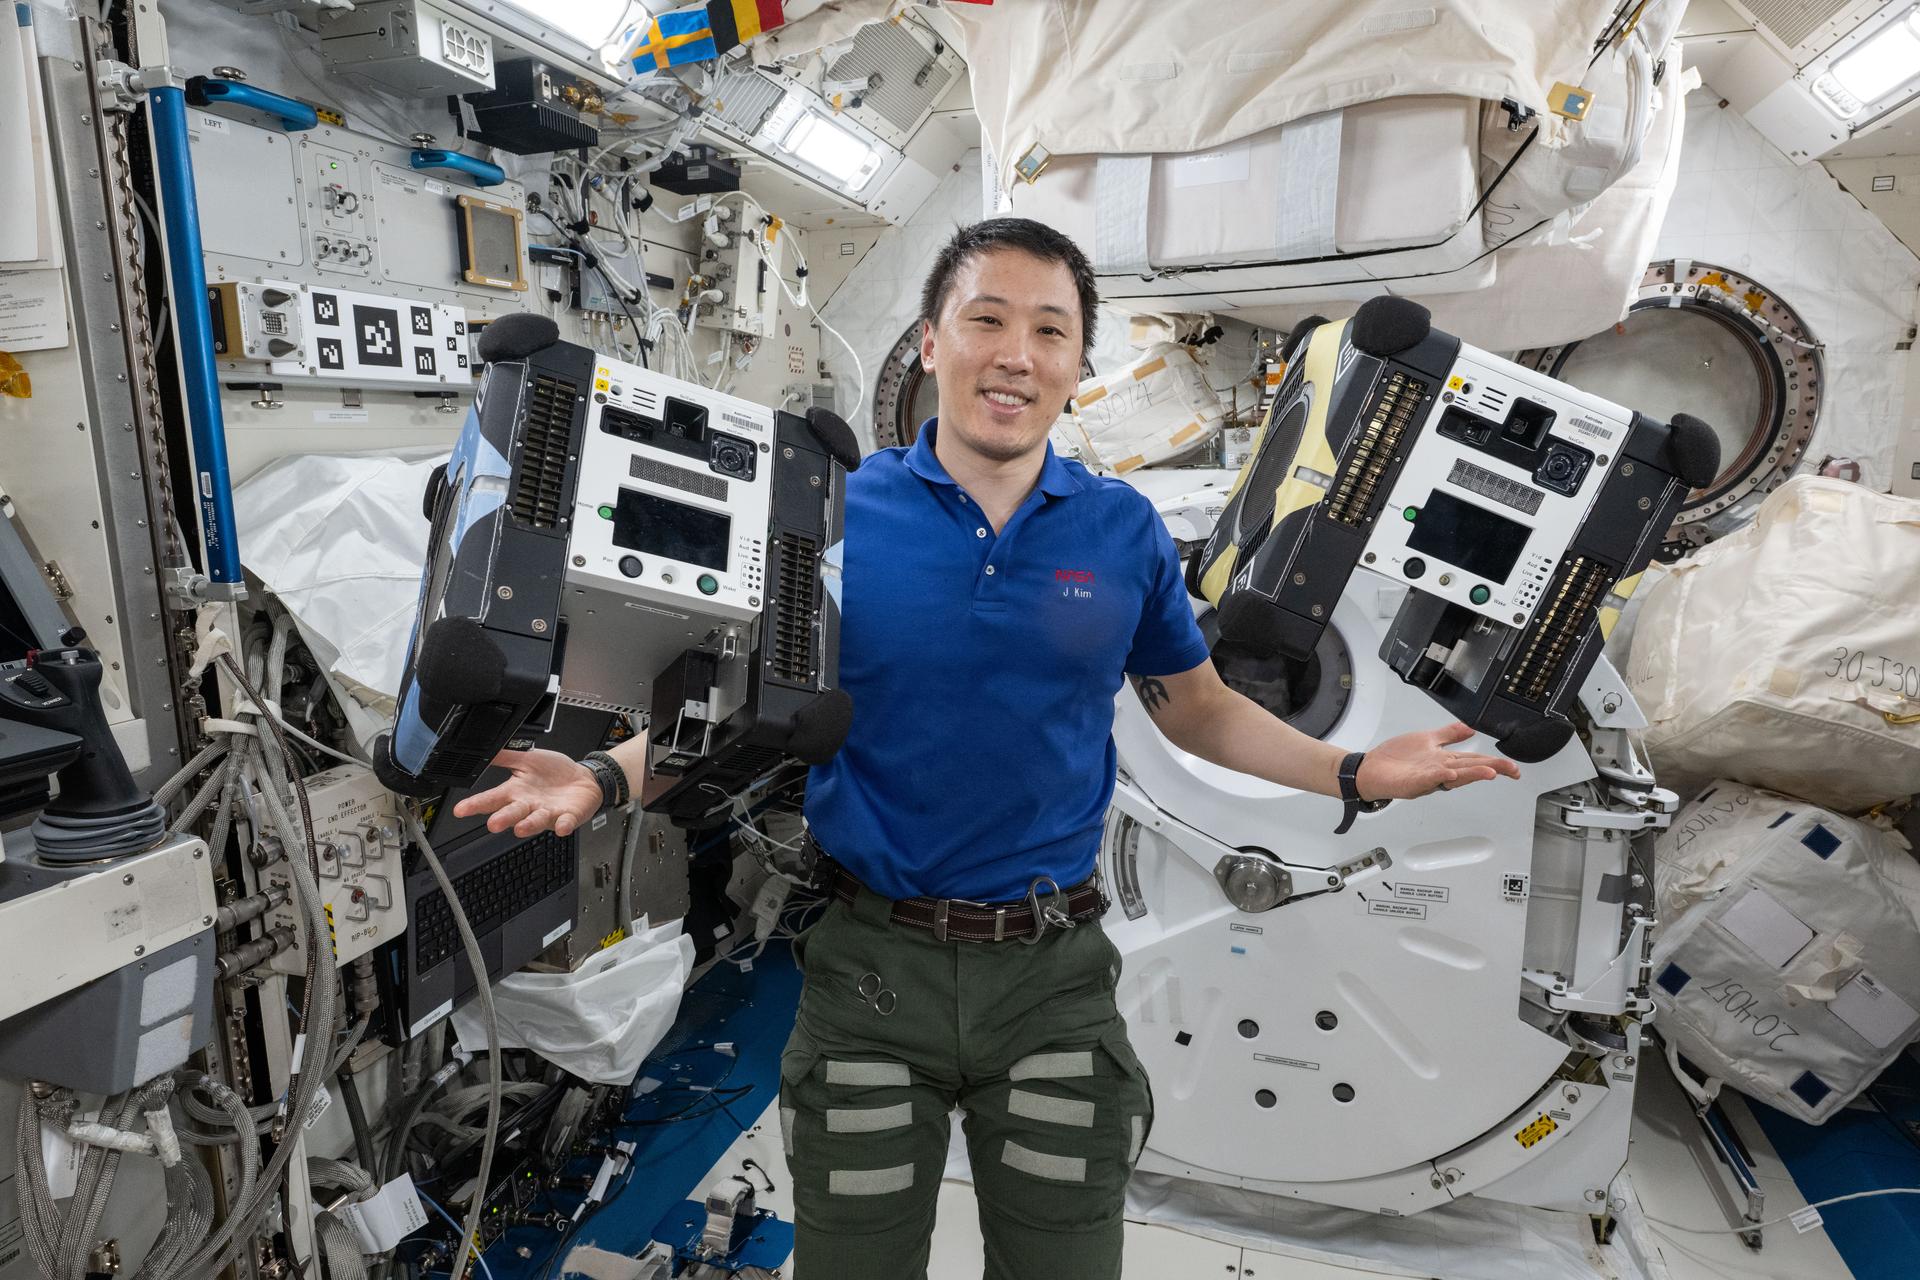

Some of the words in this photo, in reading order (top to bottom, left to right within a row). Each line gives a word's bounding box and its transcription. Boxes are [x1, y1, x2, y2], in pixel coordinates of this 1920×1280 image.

[204, 118, 223, 129] LEFT
[1055, 569, 1095, 585] NASA
[1063, 587, 1069, 597] J
[1074, 587, 1092, 598] Kim
[1825, 646, 1920, 698] 3.0-J30
[338, 799, 356, 809] POWER
[328, 815, 339, 824] END
[341, 804, 367, 819] EFFECTOR
[1701, 977, 1799, 1051] 2.0-4057
